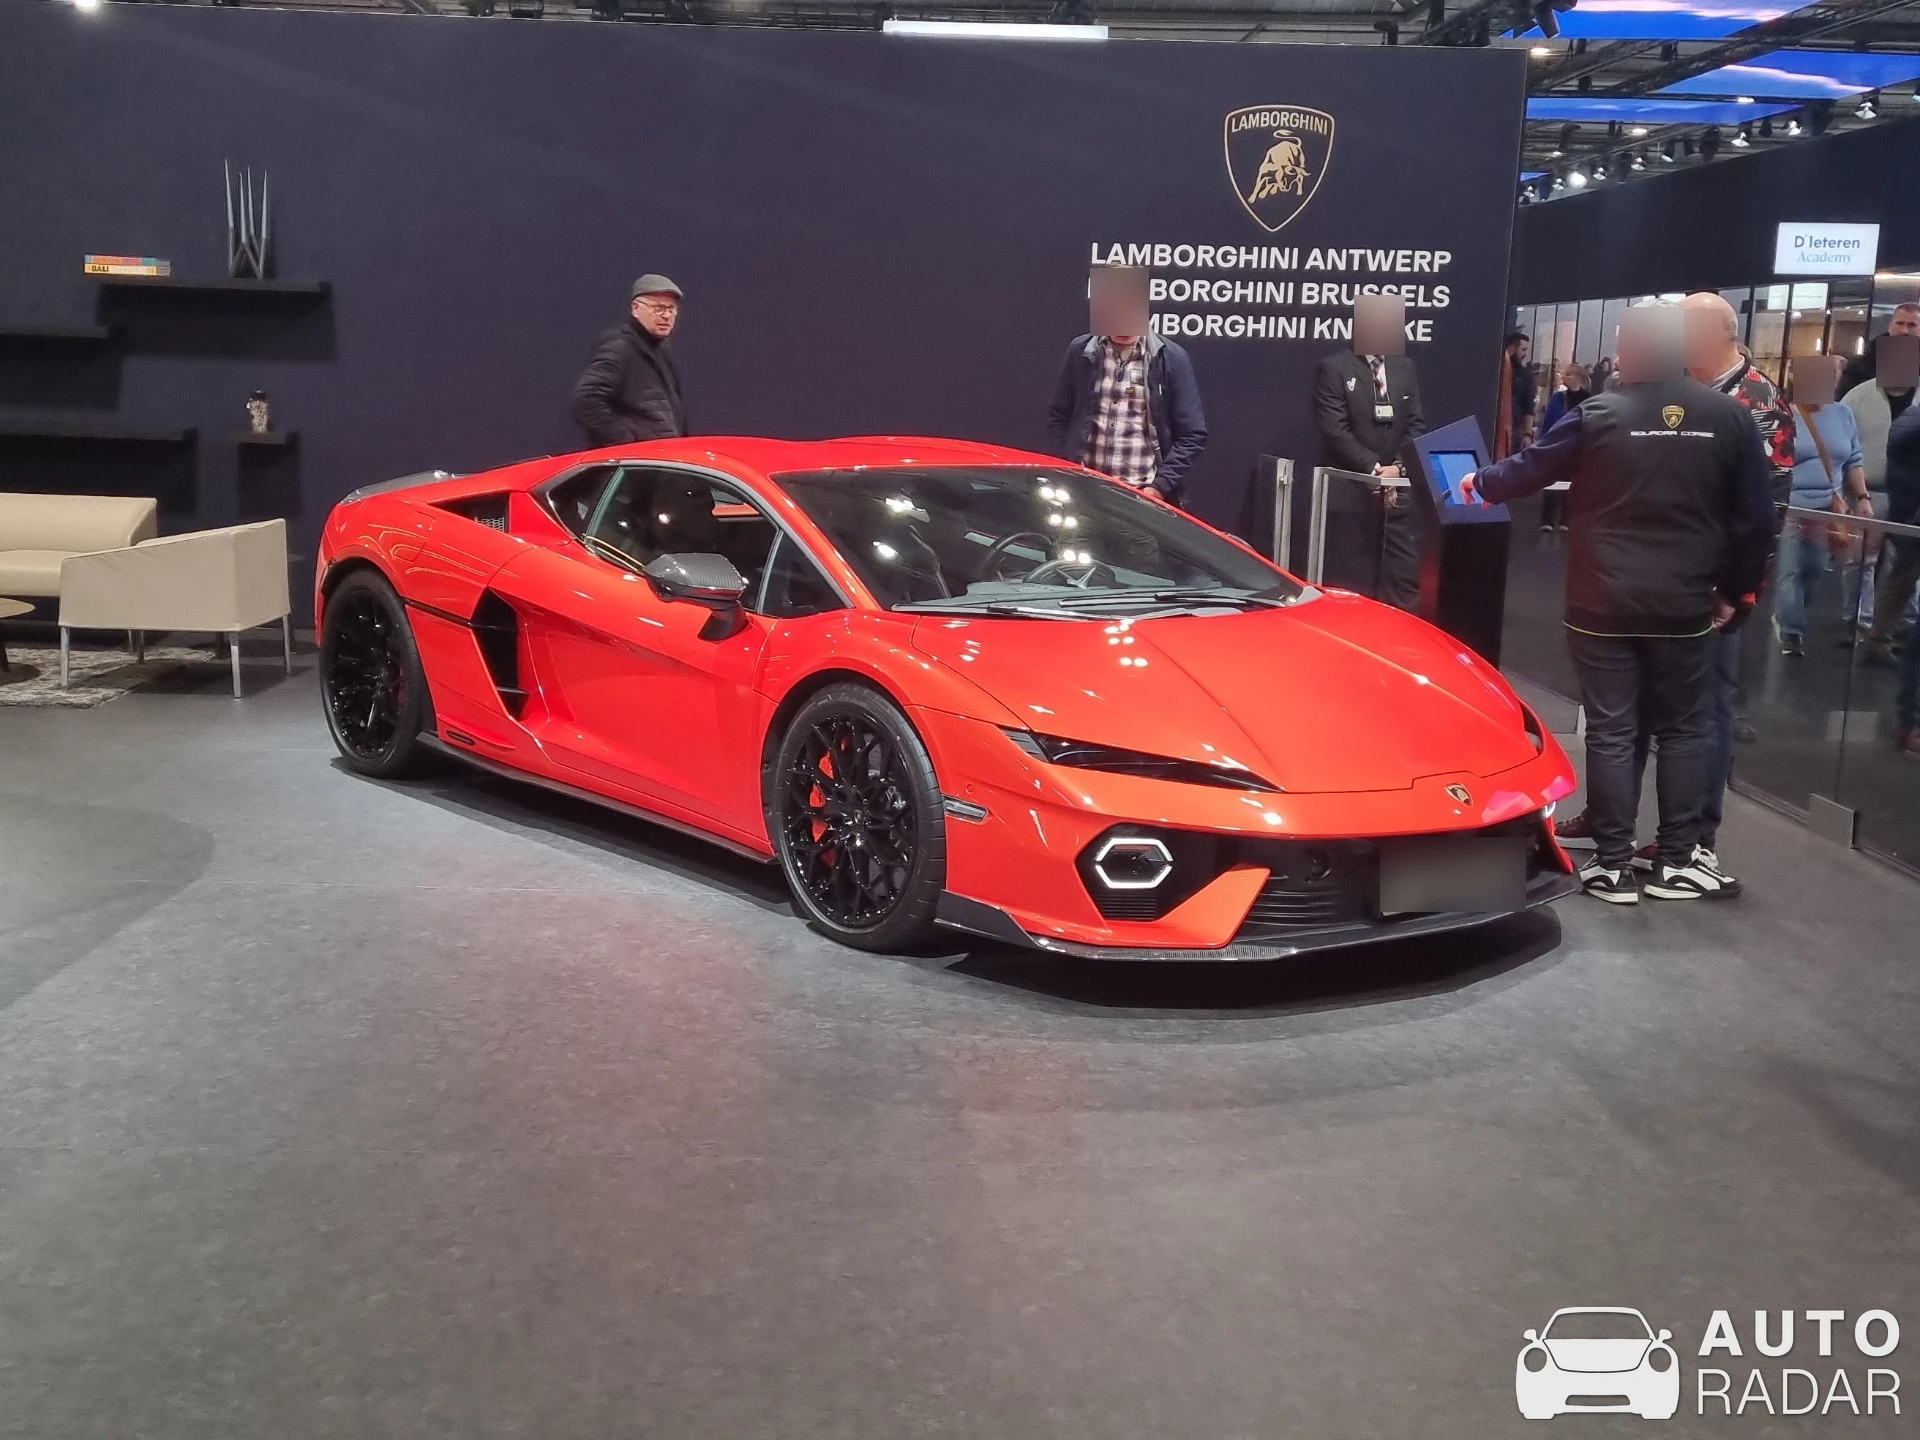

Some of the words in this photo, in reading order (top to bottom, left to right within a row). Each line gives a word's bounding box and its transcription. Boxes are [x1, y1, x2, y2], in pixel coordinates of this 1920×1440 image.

[1231, 110, 1328, 136] LAMBORGHINI
[1091, 242, 1299, 269] LAMBORGHINI
[1304, 248, 1452, 273] ANTWERP
[1797, 251, 1853, 265] Academy
[1088, 276, 1295, 304] BORGHINI
